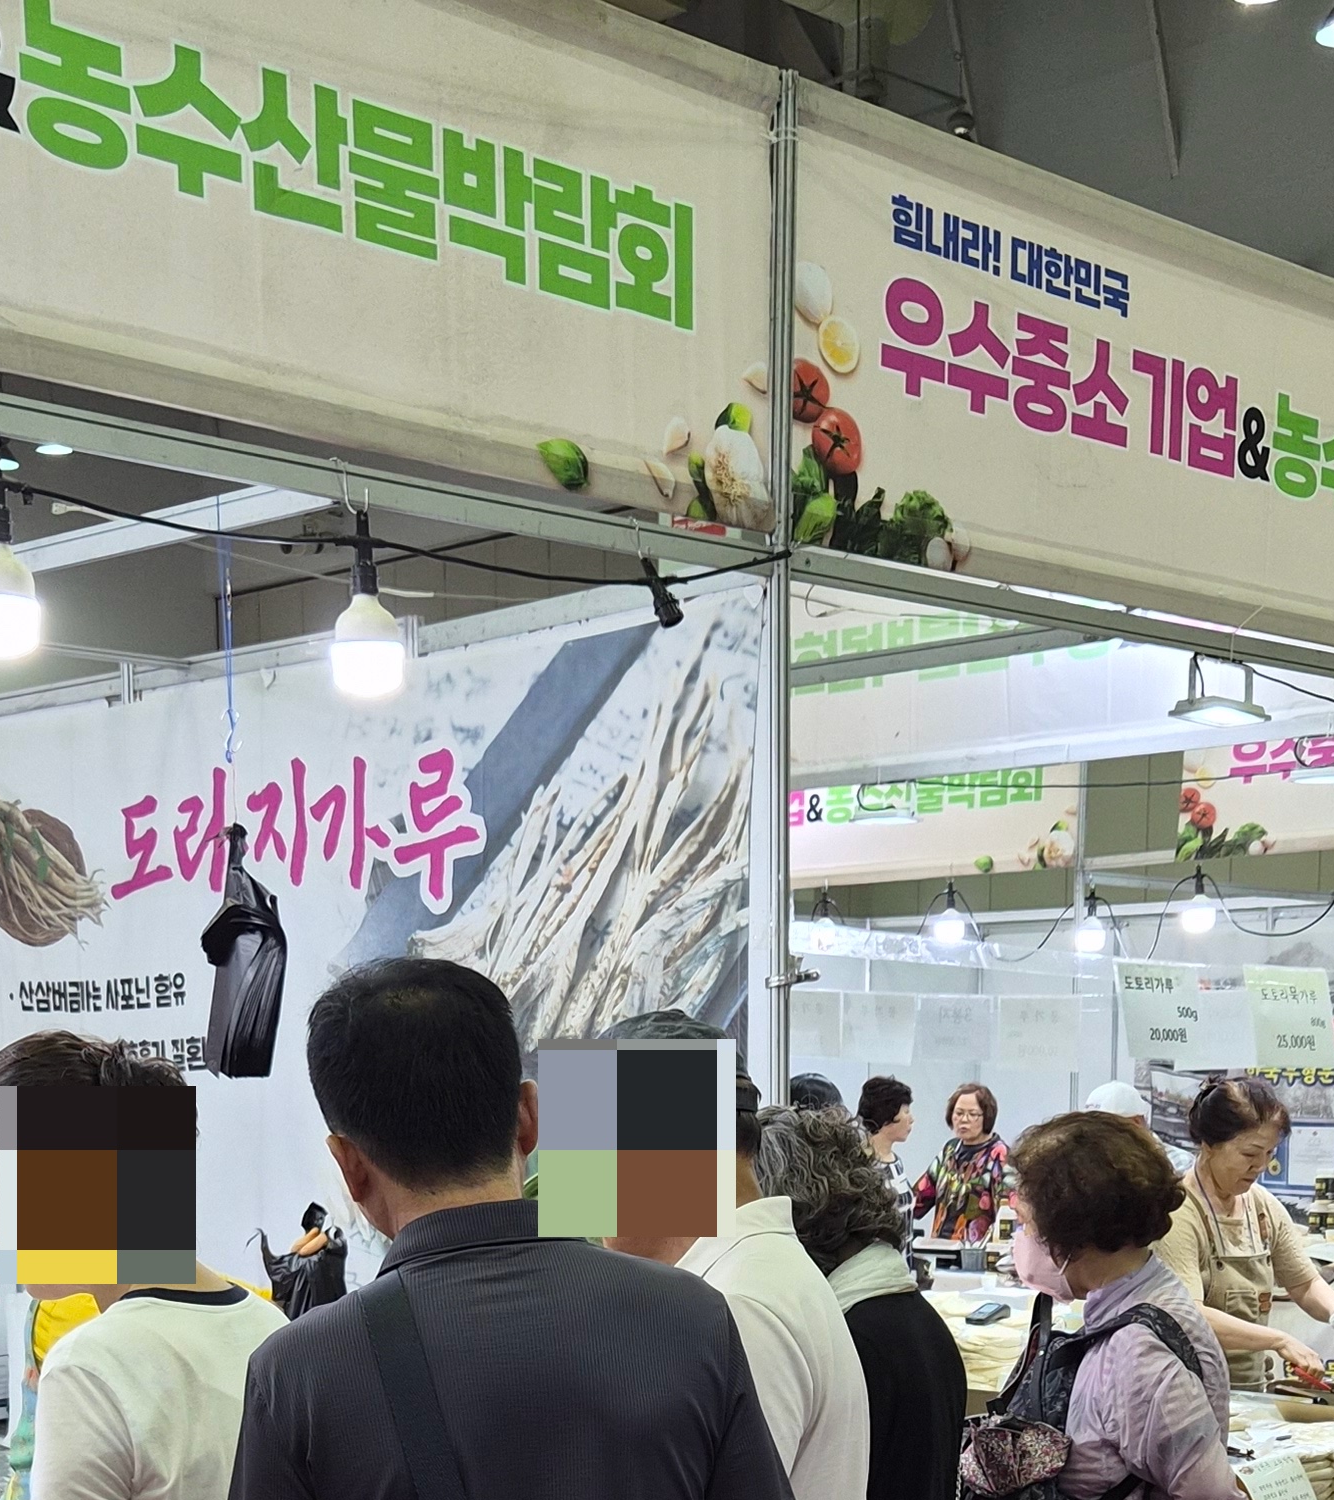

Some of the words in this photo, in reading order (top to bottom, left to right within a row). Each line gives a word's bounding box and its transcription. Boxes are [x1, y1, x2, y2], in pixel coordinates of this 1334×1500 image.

[890, 194, 1001, 278] 힘내라!
[1011, 236, 1130, 319] 대한민국
[111, 747, 479, 901] 도라지가루
[20, 980, 102, 1013] 산삼버금가는
[106, 977, 151, 1011] 사포닌
[153, 972, 186, 1008] 함유
[1125, 976, 1173, 993] 도토리가루
[1261, 987, 1317, 1004] 도토리묵가루
[1177, 1006, 1198, 1021] 500g
[1150, 1028, 1188, 1043] 20,000원
[1276, 1035, 1315, 1051] 25,000원
